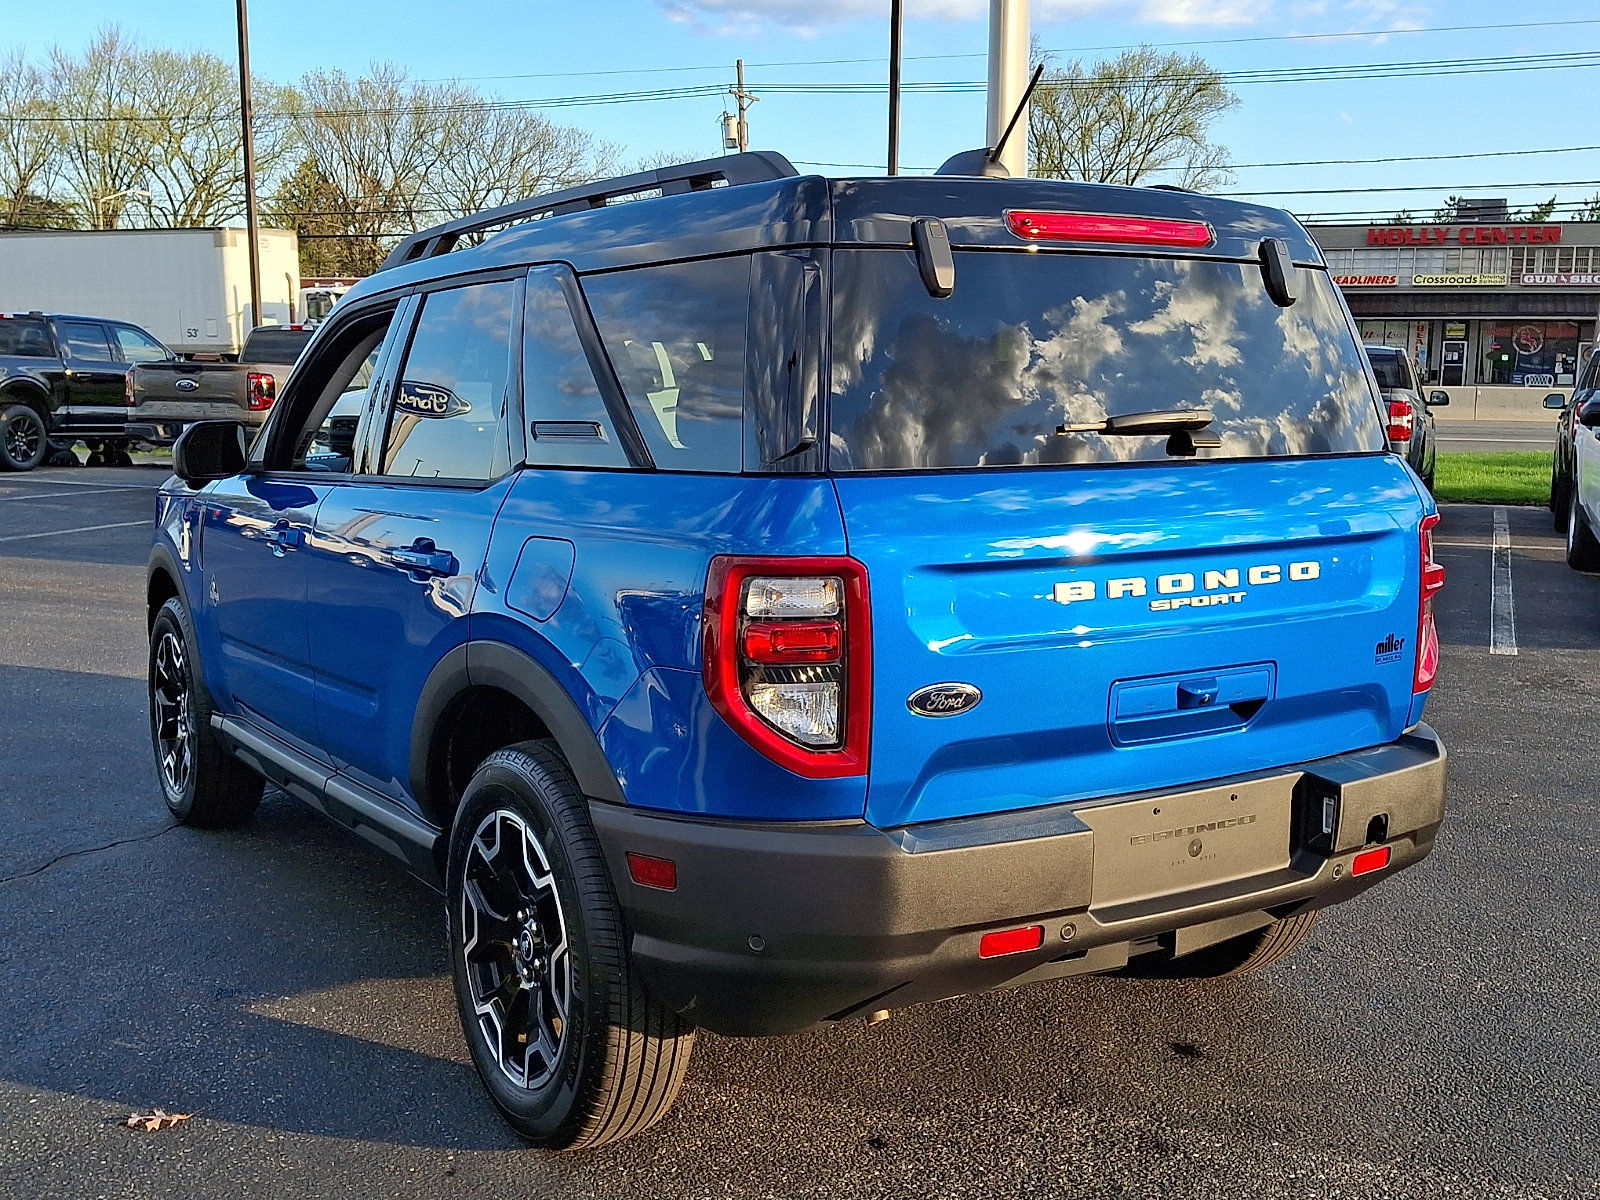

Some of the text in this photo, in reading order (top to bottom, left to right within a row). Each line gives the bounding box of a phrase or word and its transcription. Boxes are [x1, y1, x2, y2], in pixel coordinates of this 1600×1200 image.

[1367, 226, 1561, 245] HOLLY CENTER
[1413, 274, 1478, 285] Crossroads
[1523, 274, 1558, 284] GUN
[1054, 561, 1321, 603] BRONCO
[1149, 592, 1247, 611] SPORT
[1375, 632, 1406, 656] miller
[925, 690, 968, 711] Ford
[1130, 814, 1257, 846] BRONCO
